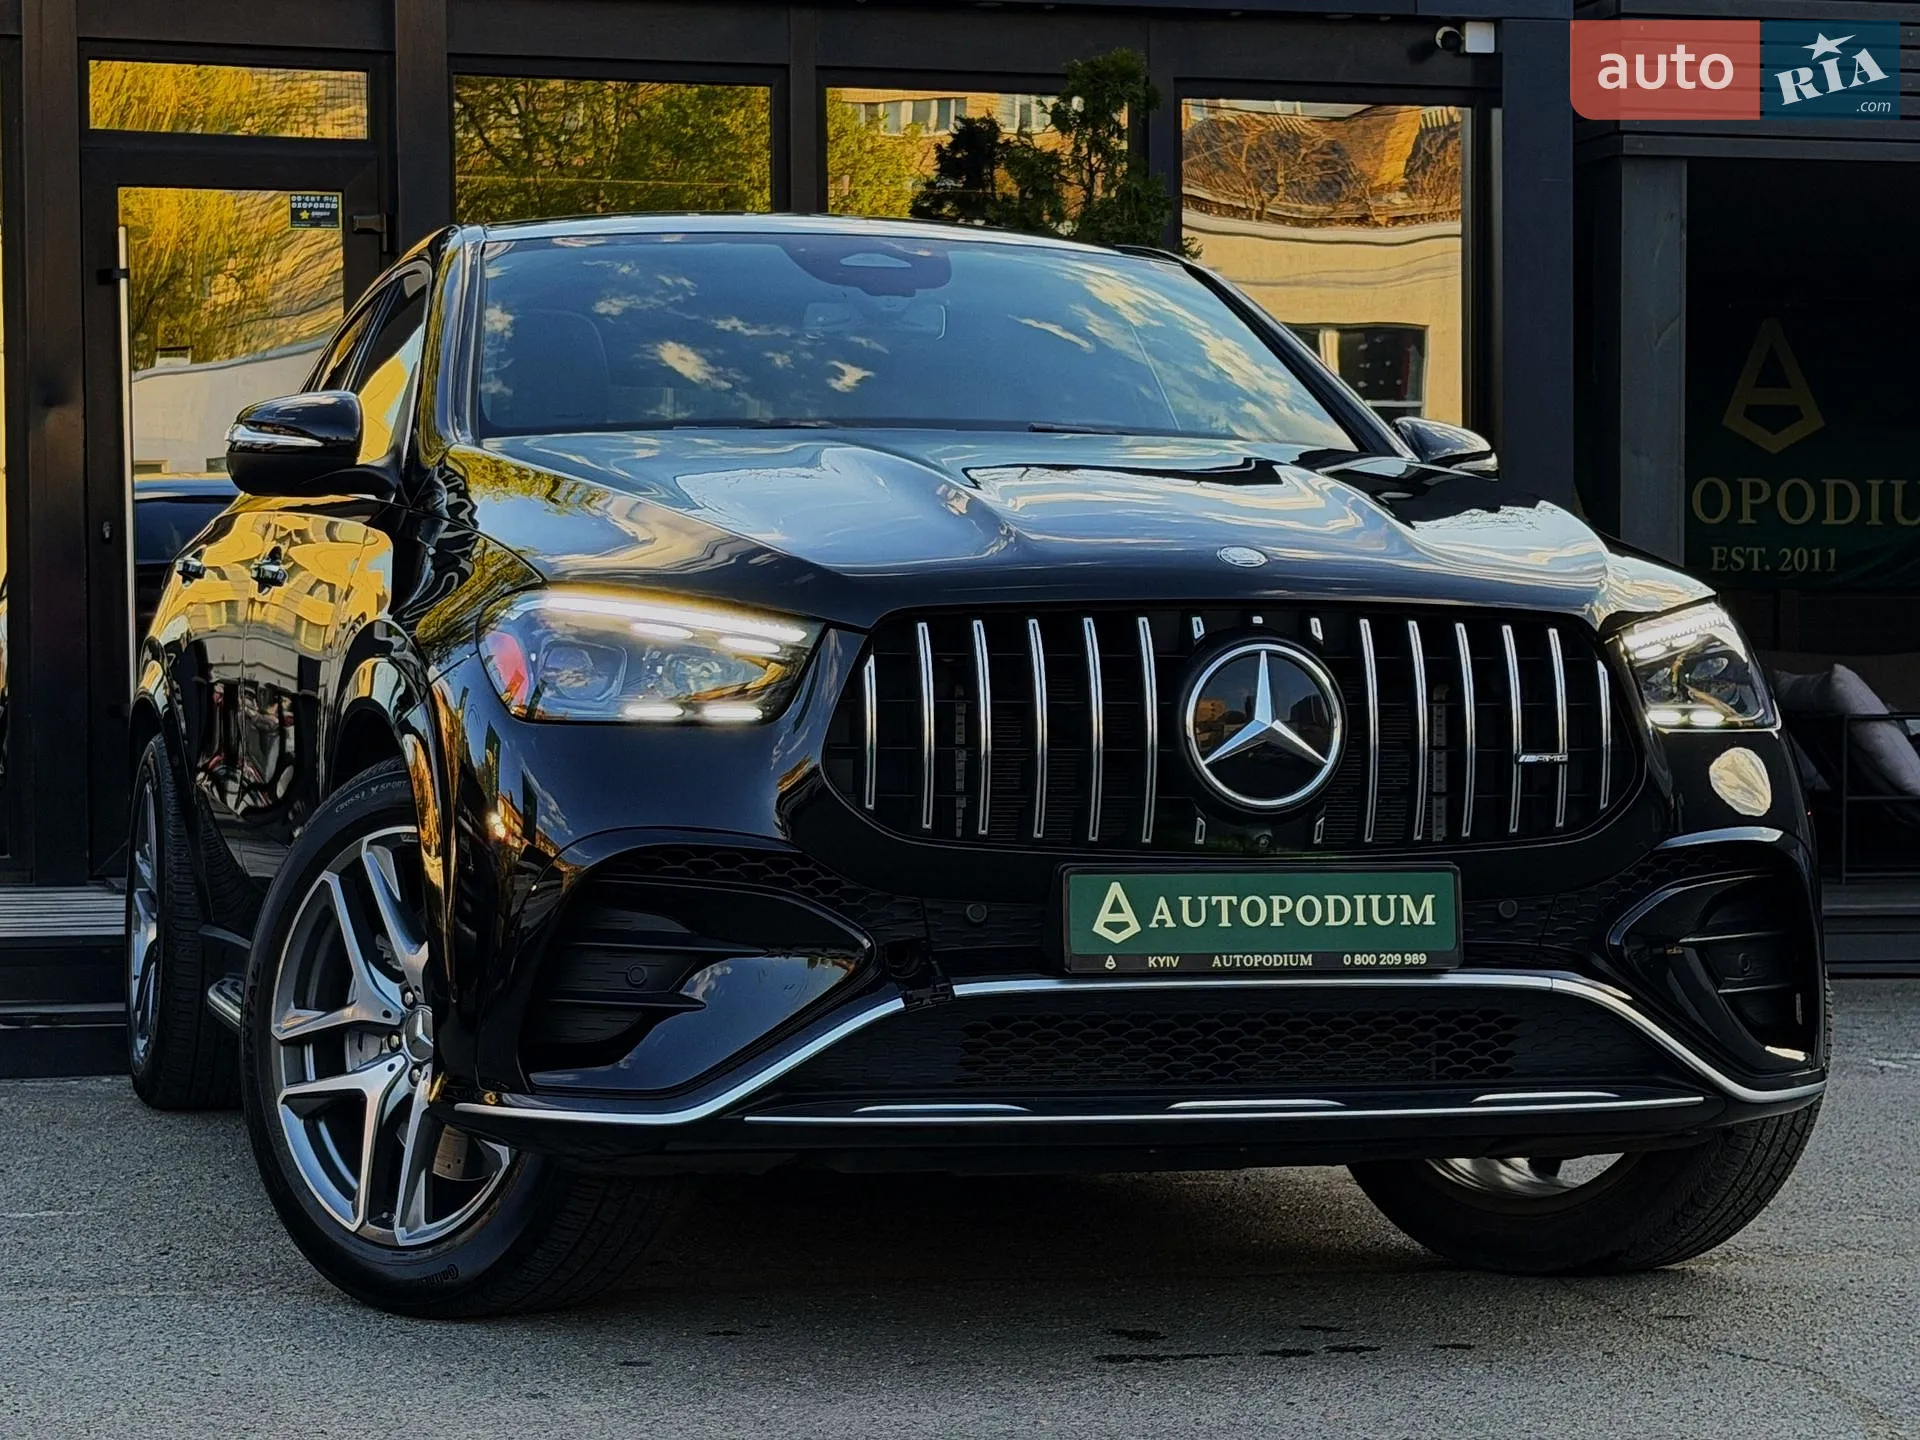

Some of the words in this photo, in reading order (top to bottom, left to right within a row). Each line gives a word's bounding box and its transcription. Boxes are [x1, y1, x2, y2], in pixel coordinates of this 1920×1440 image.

[1709, 546, 1771, 572] EST.
[1777, 547, 1837, 572] 2011
[1149, 894, 1436, 929] AUTOPODIUM
[1147, 955, 1180, 969] KYIV
[1211, 954, 1313, 967] AUTOPODIUM
[1343, 954, 1352, 966] 0
[1353, 954, 1378, 966] 800
[1379, 953, 1401, 966] 209
[1403, 952, 1427, 966] 989
